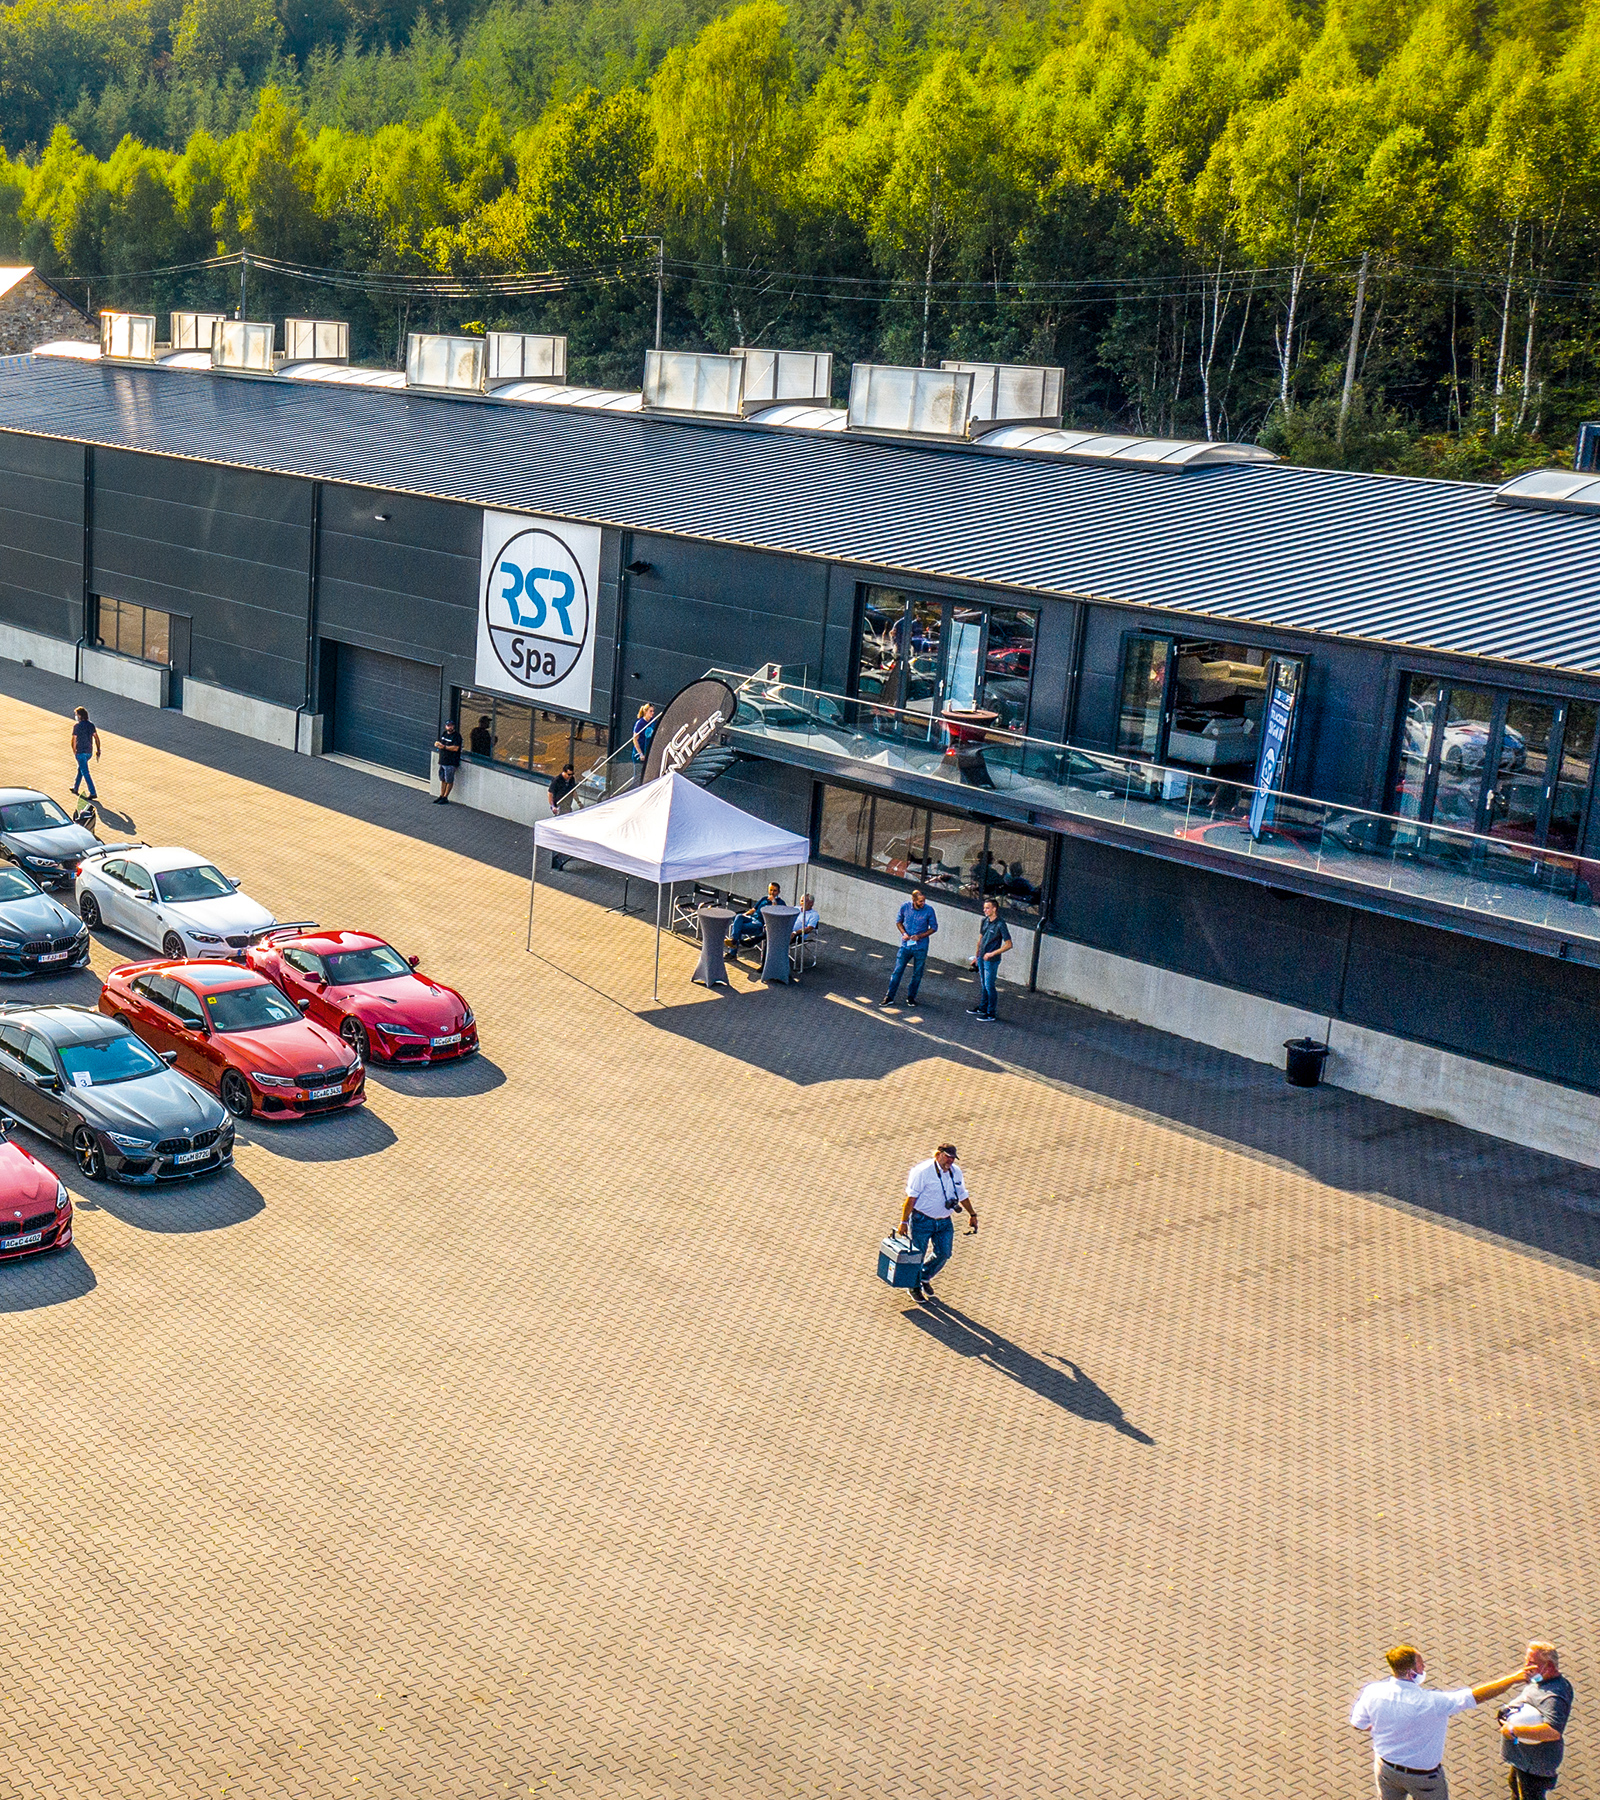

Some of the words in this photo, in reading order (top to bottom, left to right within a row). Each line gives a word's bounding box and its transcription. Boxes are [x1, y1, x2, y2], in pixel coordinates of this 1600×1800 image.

[500, 561, 575, 636] RSR
[510, 638, 556, 680] Spa
[660, 723, 689, 777] AC
[80, 1079, 88, 1087] 3
